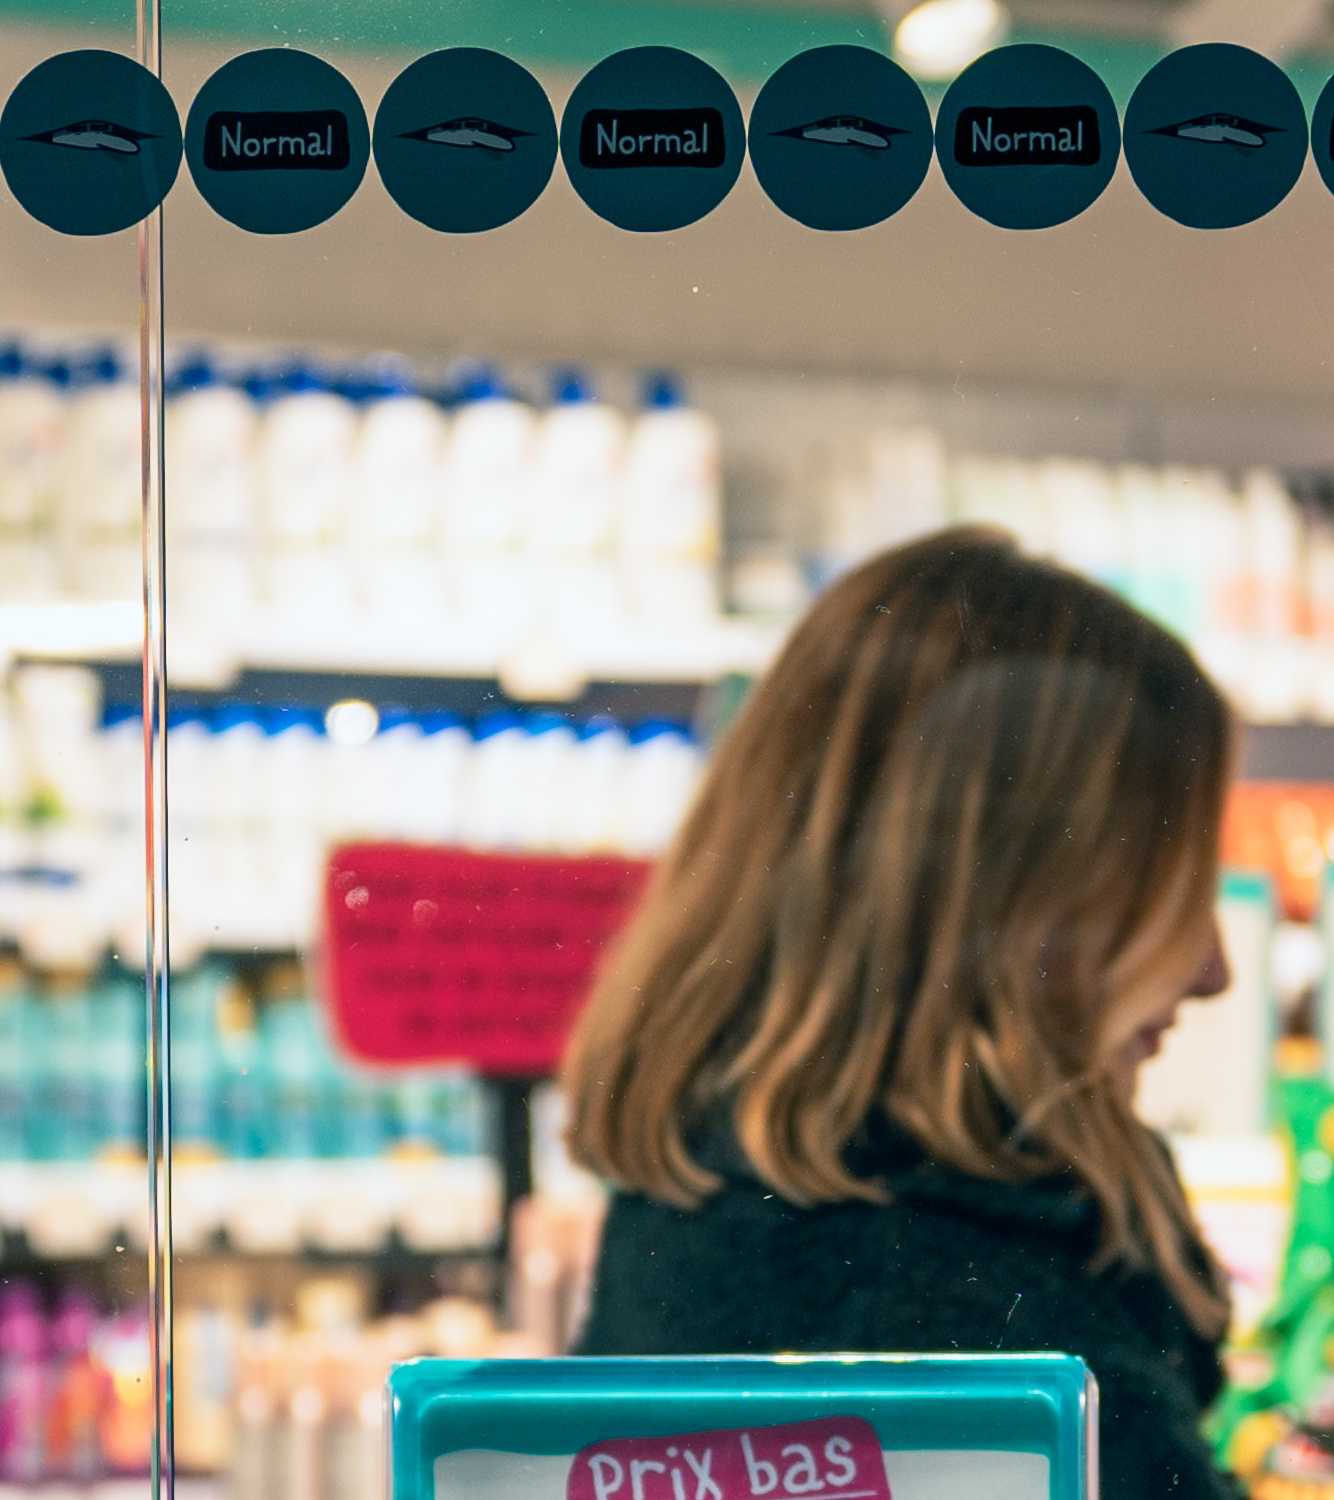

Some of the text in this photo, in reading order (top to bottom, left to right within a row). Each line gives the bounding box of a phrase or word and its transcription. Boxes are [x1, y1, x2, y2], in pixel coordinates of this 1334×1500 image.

[221, 121, 332, 158] Normal
[597, 119, 708, 156] Normal
[972, 116, 1083, 153] Normal
[740, 1432, 857, 1495] bas
